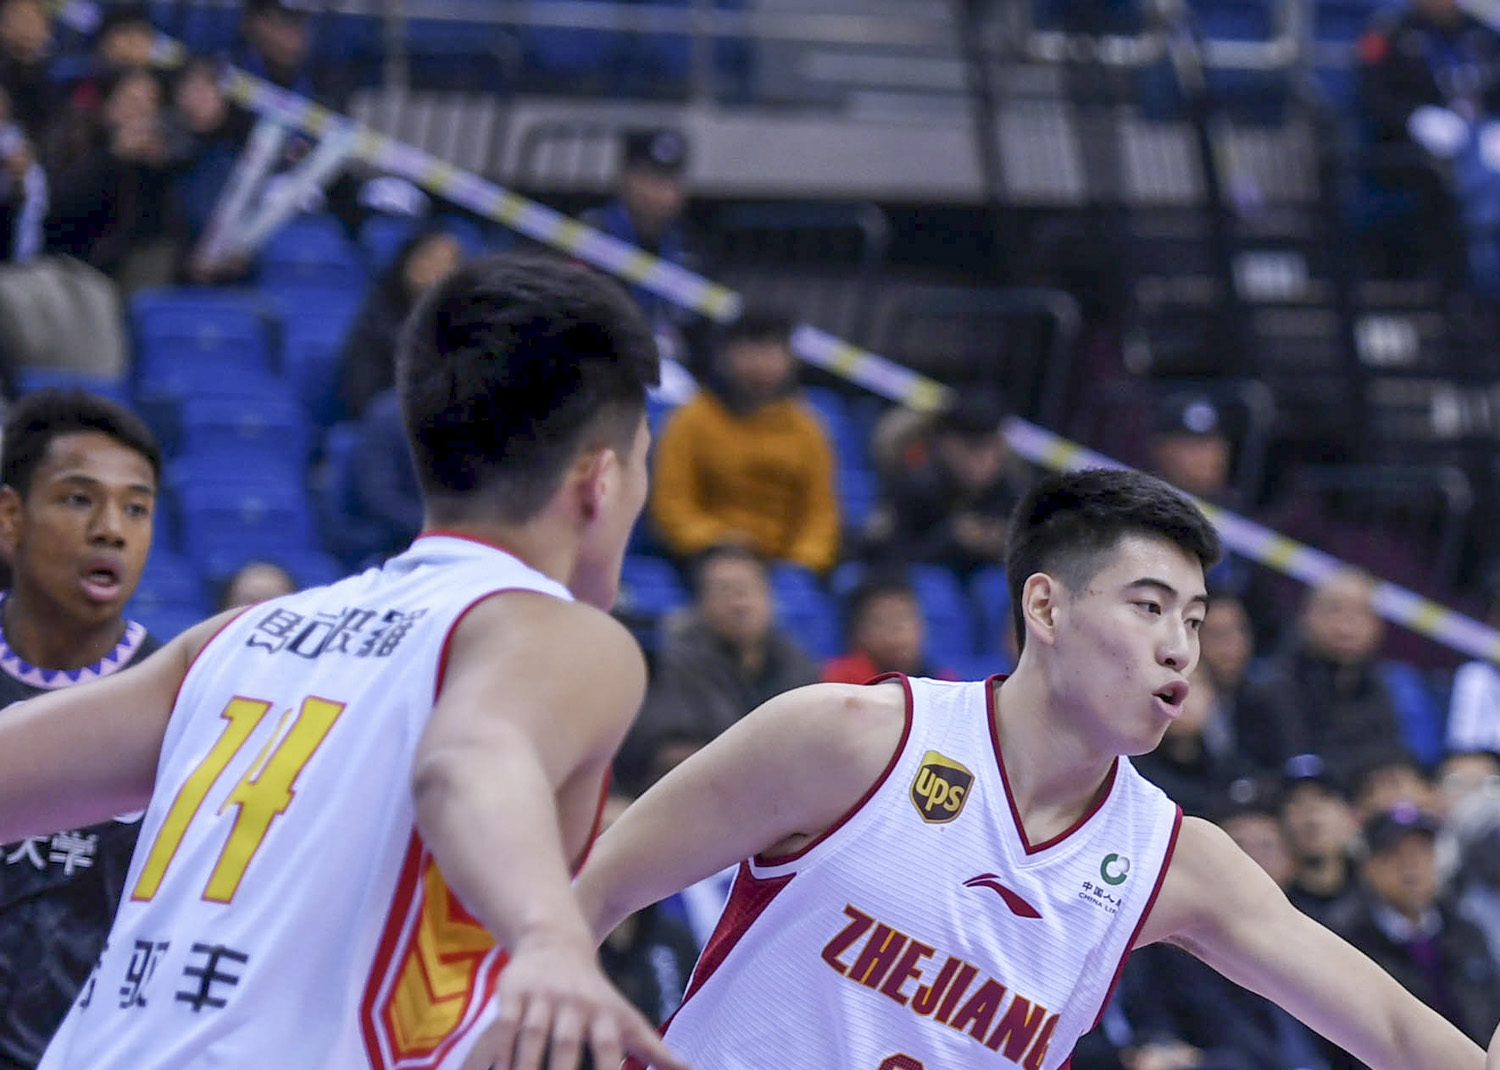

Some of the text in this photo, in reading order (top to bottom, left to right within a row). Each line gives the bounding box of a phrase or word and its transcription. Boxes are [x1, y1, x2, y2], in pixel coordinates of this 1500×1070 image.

[129, 694, 348, 905] 14
[915, 767, 965, 811] ups
[0, 831, 98, 876] 大学
